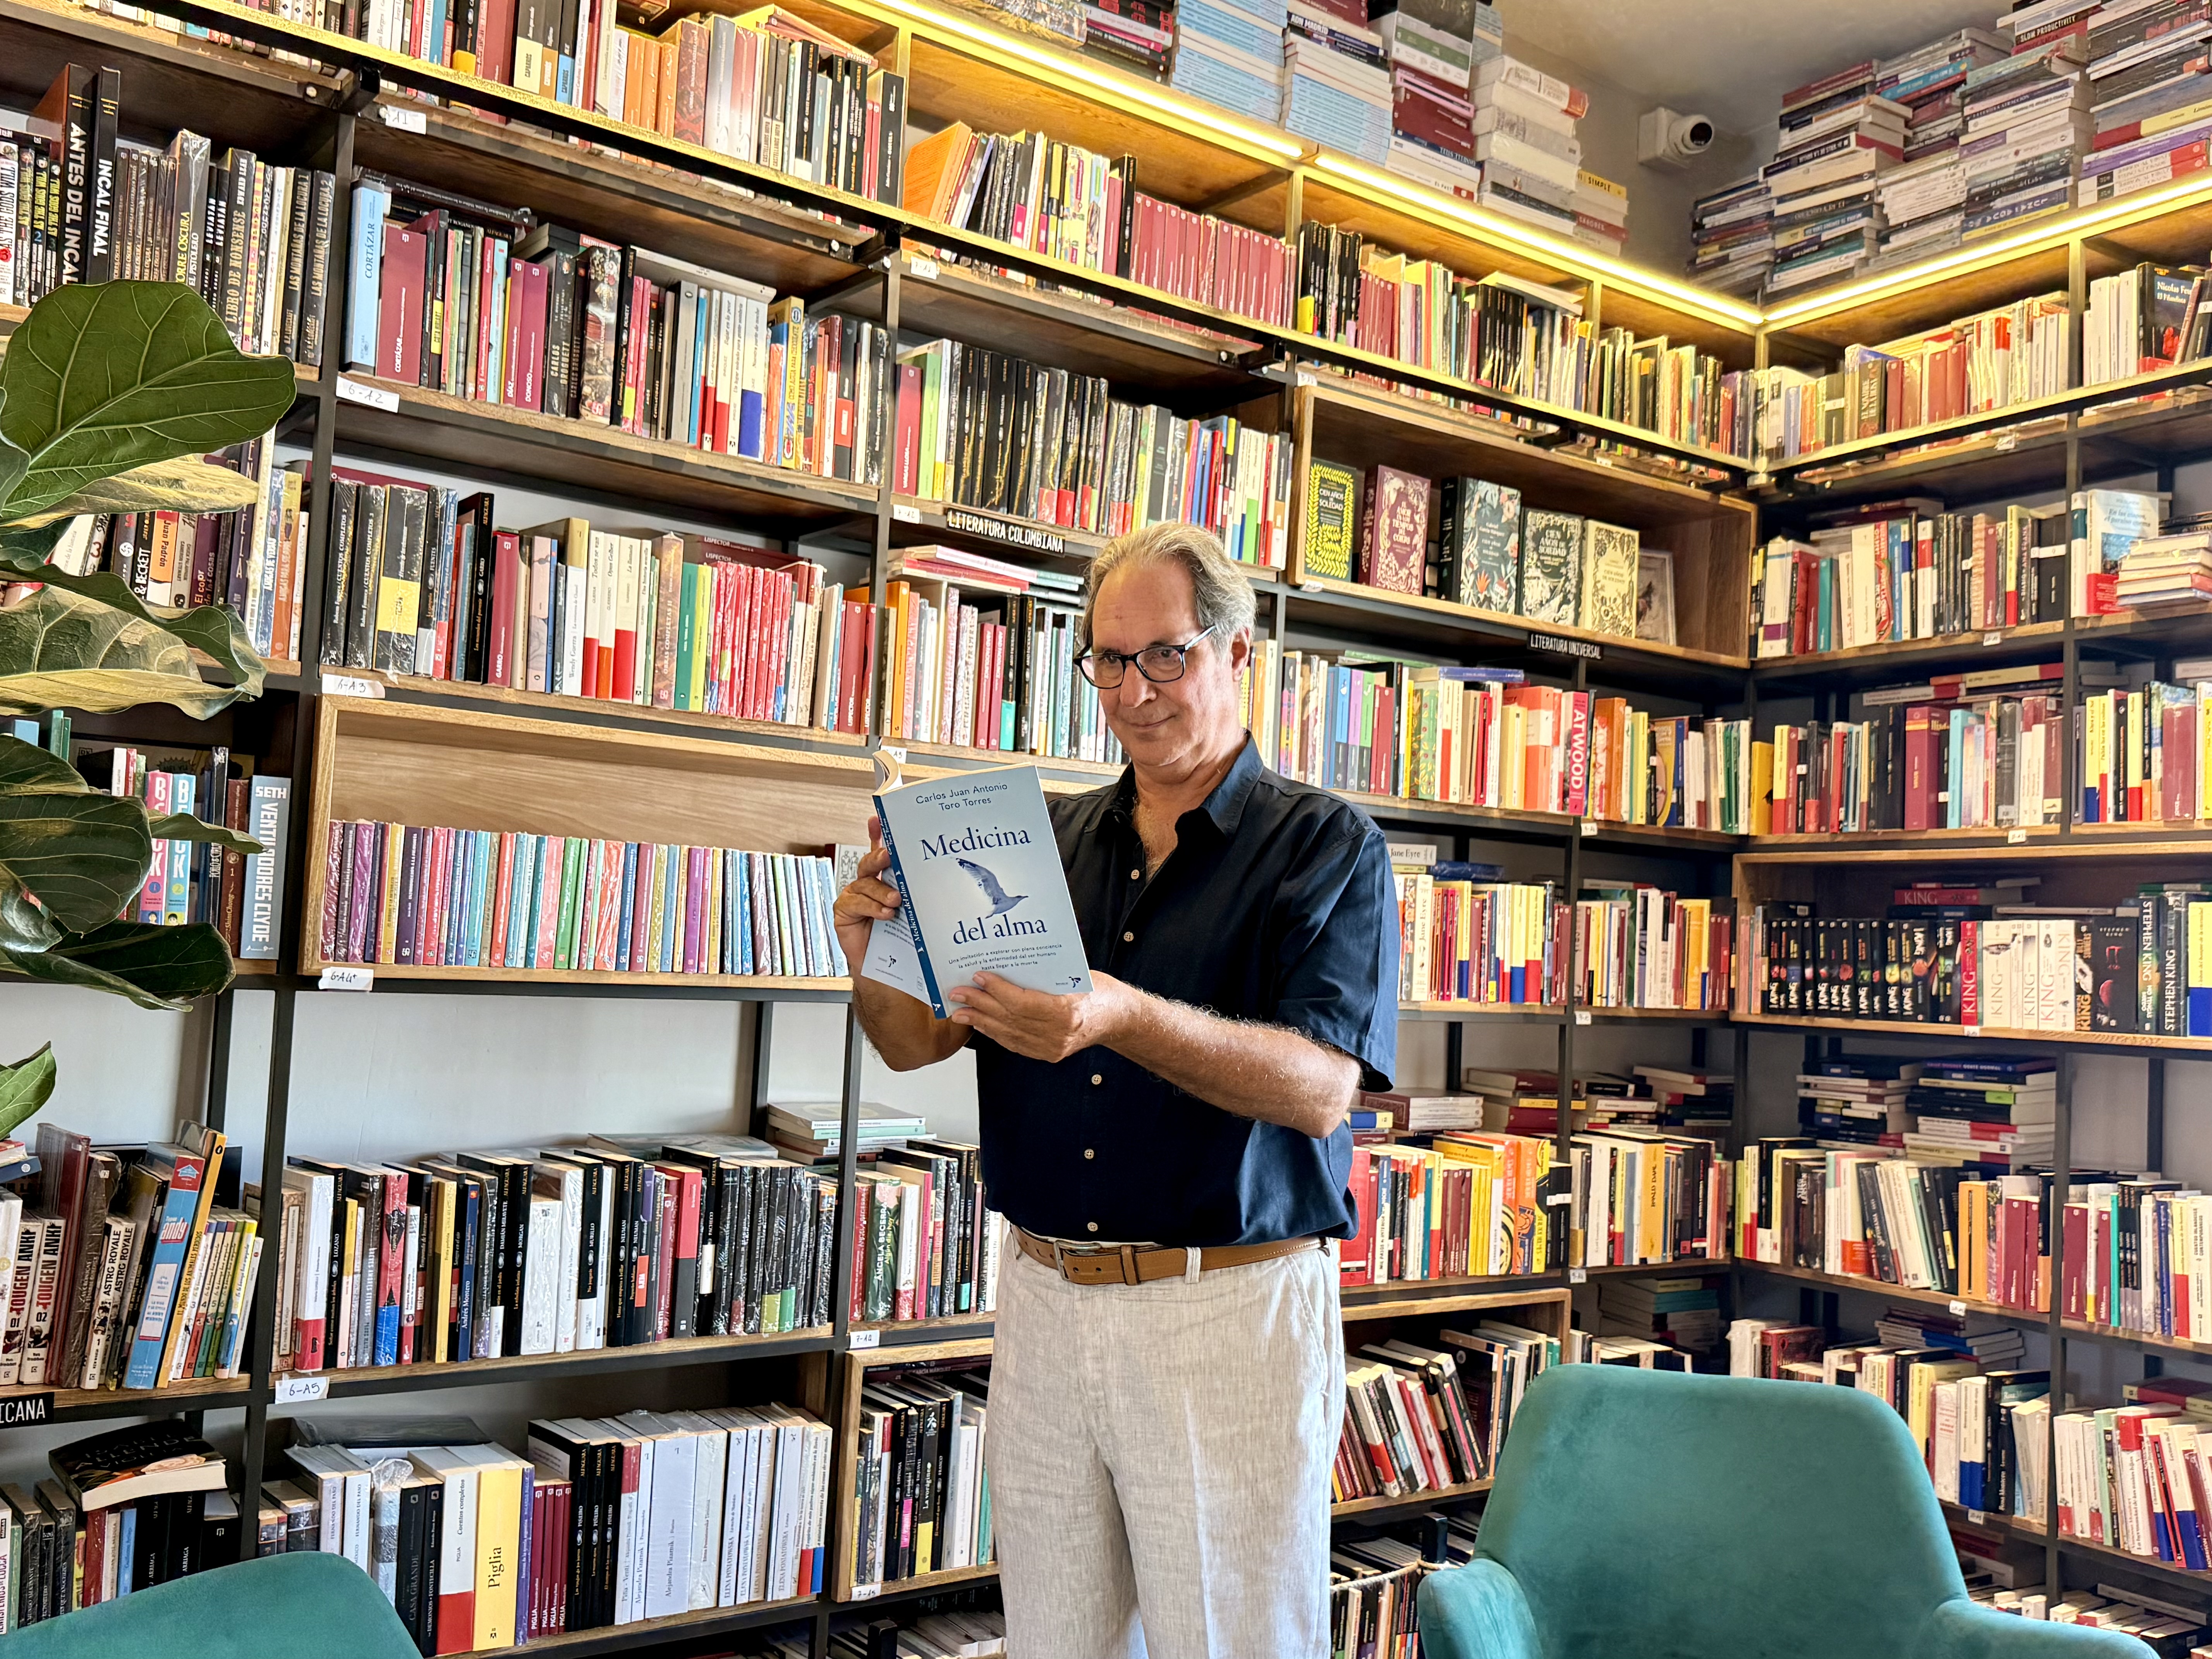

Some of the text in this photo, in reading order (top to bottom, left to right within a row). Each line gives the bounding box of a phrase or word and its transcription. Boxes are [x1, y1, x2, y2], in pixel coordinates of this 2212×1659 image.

[1290, 14, 1329, 35] ADN MADRID
[2020, 15, 2075, 43] SLOW PRODUCTIVITY
[296, 183, 307, 212] LOCURA
[1589, 177, 1611, 192] SIMPLE
[62, 122, 86, 284] ANTES DEL INCAL
[93, 159, 113, 256] INCAL FINAL
[294, 213, 304, 223] LA
[34, 231, 41, 242] 2
[294, 223, 304, 235] DE
[175, 212, 190, 283] ORRE OSCURA
[365, 223, 375, 278] CORTÁZAR
[225, 210, 245, 323] LIBRO DE NONSENSE
[289, 276, 299, 291] LAS
[395, 337, 403, 373] CORTÁZAR
[551, 345, 560, 377] CARLOS
[561, 342, 570, 385] DROGUETT
[1319, 488, 1344, 500] CIEN AÑOS
[1319, 499, 1343, 510] SOLEDAD
[1396, 507, 1411, 516] AMOR
[704, 537, 730, 547] LISPECTOR
[948, 510, 1063, 553] LITERATURA COLOMBIANA
[1393, 520, 1413, 531] TIEMPOS
[1540, 537, 1558, 548] AÑOS
[1545, 529, 1561, 539] CIEN
[159, 520, 172, 568] Juan Padrón
[706, 552, 731, 562] LISPECTOR
[1538, 546, 1566, 557] SOLEDAD
[134, 546, 151, 596] & BECKETT
[1530, 634, 1601, 659] LITERATURA UNIVERSAL
[1571, 709, 1585, 789] ATWOOD
[255, 786, 287, 799] SETH
[916, 783, 1008, 804] Carlos Juan Antonio
[938, 797, 991, 812] Toro Torres
[920, 826, 1032, 861] Medicina
[899, 881, 921, 942] Medicina del alma
[1904, 891, 1937, 905] KING
[252, 903, 271, 942] CLYDE
[953, 914, 1048, 944] del alma
[2058, 933, 2070, 976] KING
[2142, 901, 2152, 981] STEPHEN KING
[1963, 971, 1976, 1014] KING
[1991, 973, 2003, 1018] KING
[2024, 974, 2035, 1016] KING
[2040, 974, 2054, 1022] KING
[2164, 950, 2176, 1031] STEPHEN KING
[109, 1230, 121, 1265] ROYALE
[875, 1201, 887, 1281] ÁNGELA BECERRA
[10, 1229, 36, 1316] TOUGEN ANKI
[36, 1223, 62, 1309] TOUGEN ANKI
[10, 1318, 20, 1328] 01
[36, 1312, 47, 1322] 02
[289, 1383, 320, 1396] 6-A5
[923, 1498, 929, 1509] La
[488, 1548, 504, 1589] Piglia
[726, 1537, 734, 1579] PONIATOWSKA
[780, 1532, 789, 1573] PONIATOWSKA
[410, 1554, 419, 1595] GRANDE
